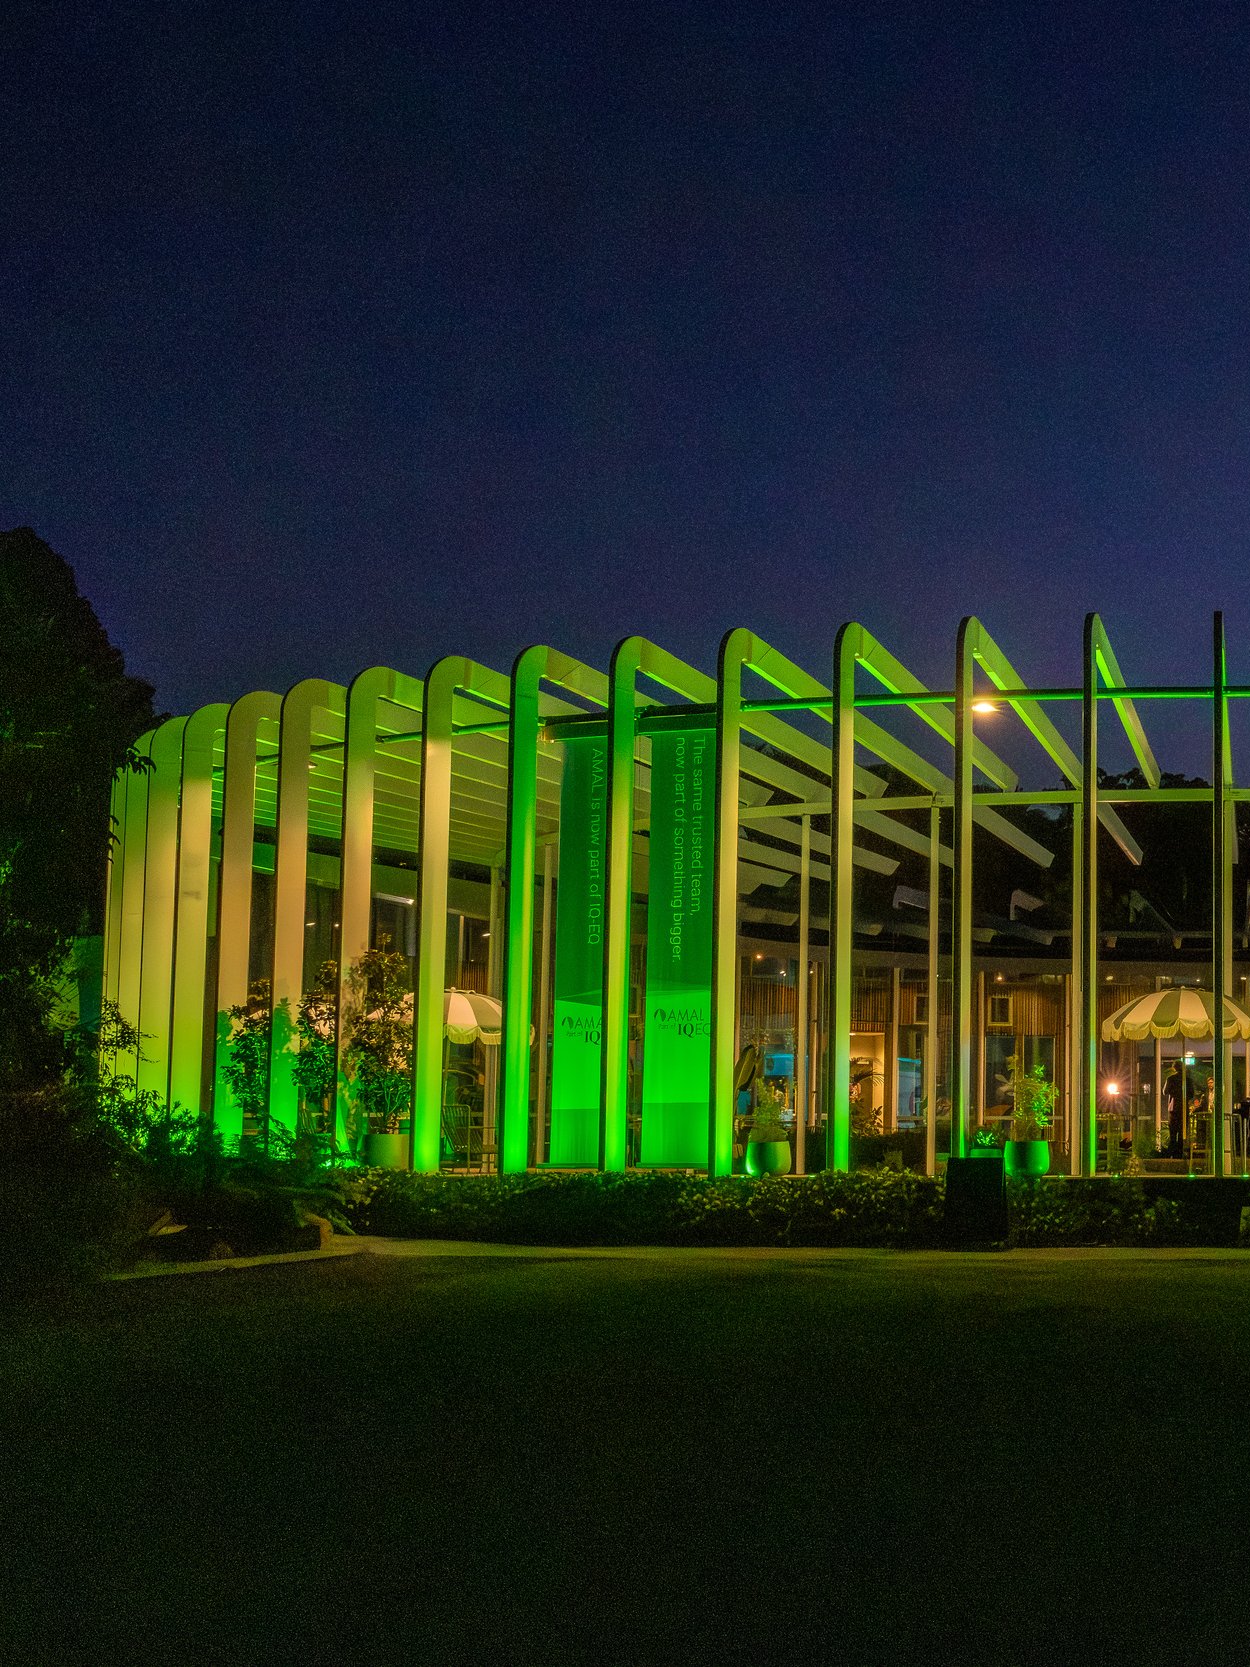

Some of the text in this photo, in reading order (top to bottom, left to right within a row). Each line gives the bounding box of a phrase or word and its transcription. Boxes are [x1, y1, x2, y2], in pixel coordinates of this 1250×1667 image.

[587, 748, 604, 945] AMAL is now part of IQ-EQ
[669, 736, 687, 963] now part of something bigger.
[689, 735, 706, 916] The same trusted team,
[574, 1017, 602, 1029] AMA
[585, 1031, 601, 1045] IQ
[667, 1009, 704, 1021] AMAL
